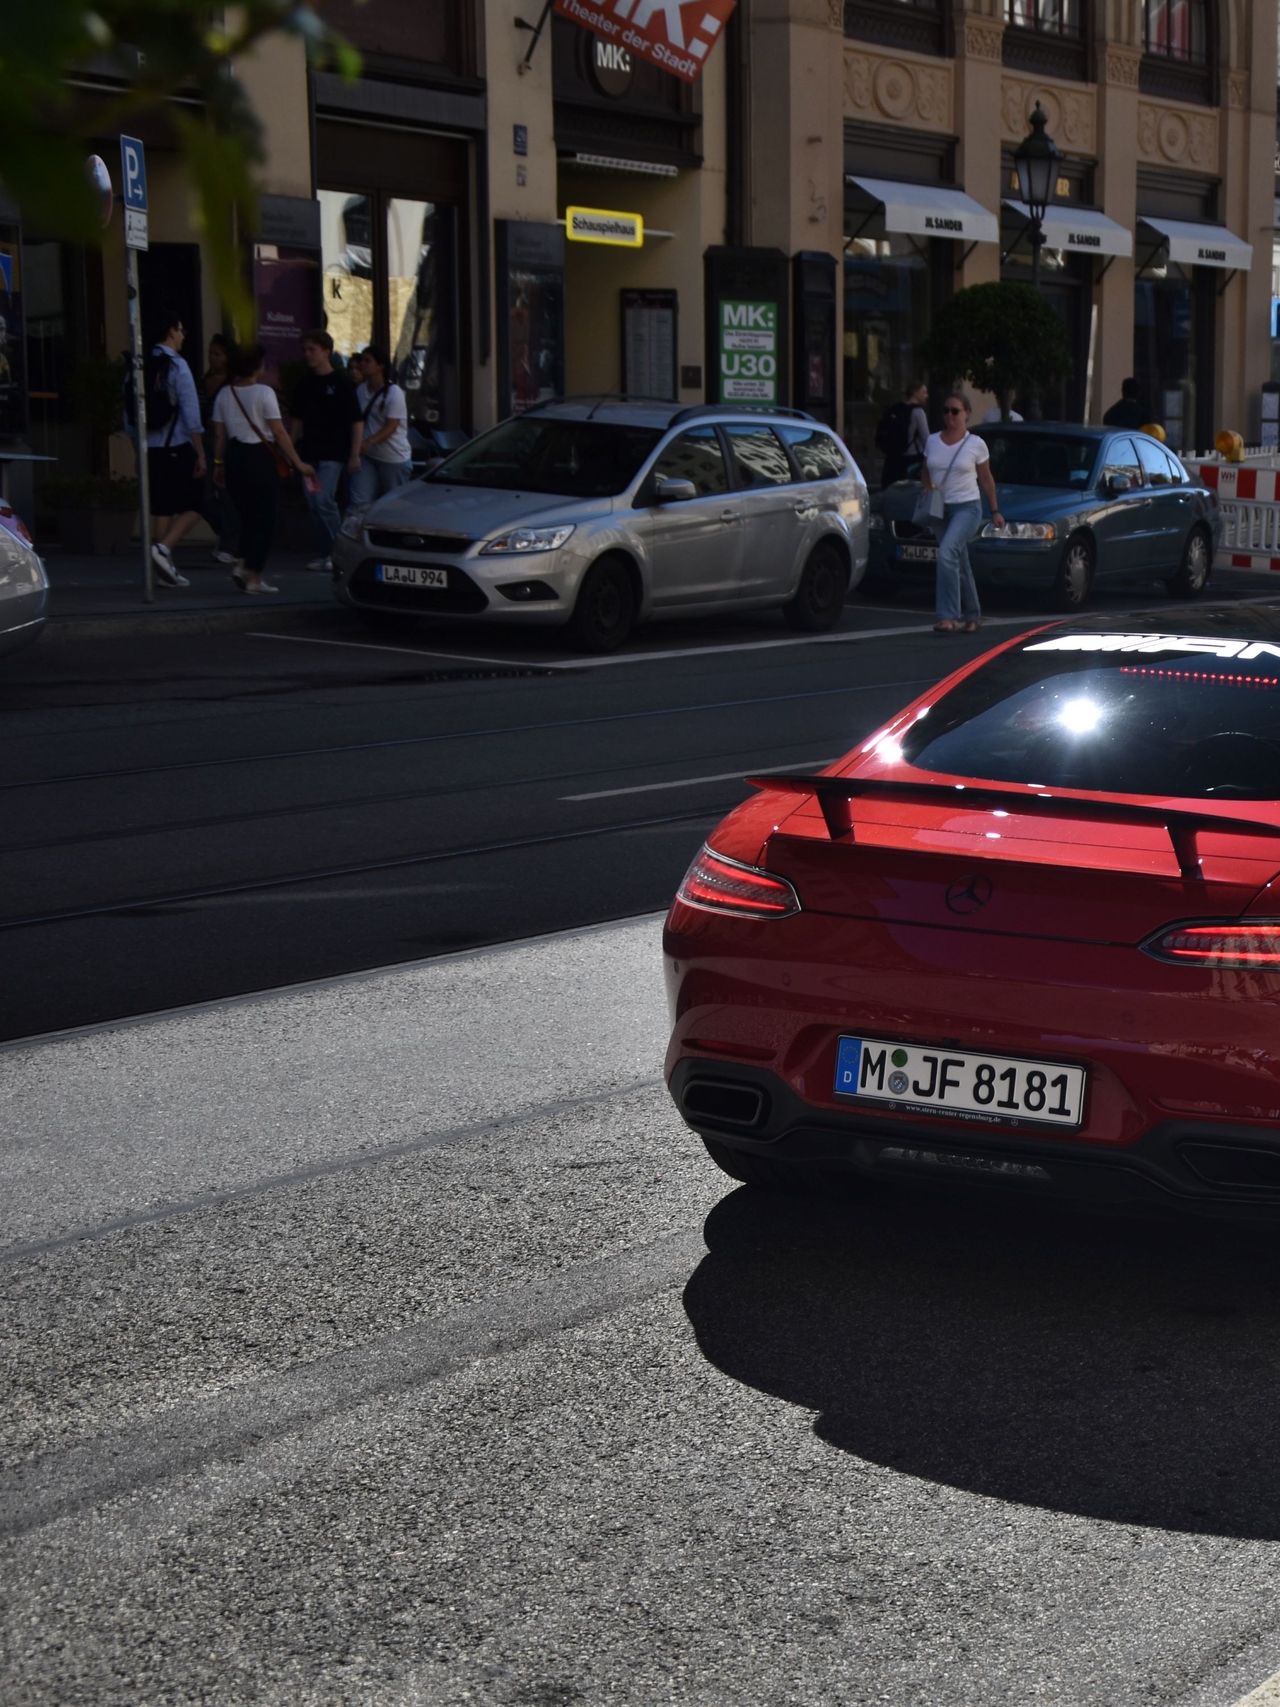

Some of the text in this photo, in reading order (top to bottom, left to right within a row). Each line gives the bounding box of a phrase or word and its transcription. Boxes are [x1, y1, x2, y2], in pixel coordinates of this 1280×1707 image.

[596, 41, 631, 72] MK:
[621, 29, 652, 51] der
[651, 43, 698, 78] Stadt
[125, 145, 140, 199] P
[572, 217, 636, 236] Schauspielhaus
[934, 217, 963, 232] SANDER
[1076, 234, 1101, 247] SANDER
[1204, 249, 1226, 261] SANDER
[723, 304, 775, 327] MK:
[720, 353, 776, 377] U30
[1220, 471, 1236, 481] WH
[915, 547, 928, 559] UC
[384, 567, 444, 586] LA U 994
[843, 1071, 852, 1083] D
[860, 1047, 1072, 1117] M JF 8181
[905, 1103, 1002, 1124] www.stern-center-regensburg.de
